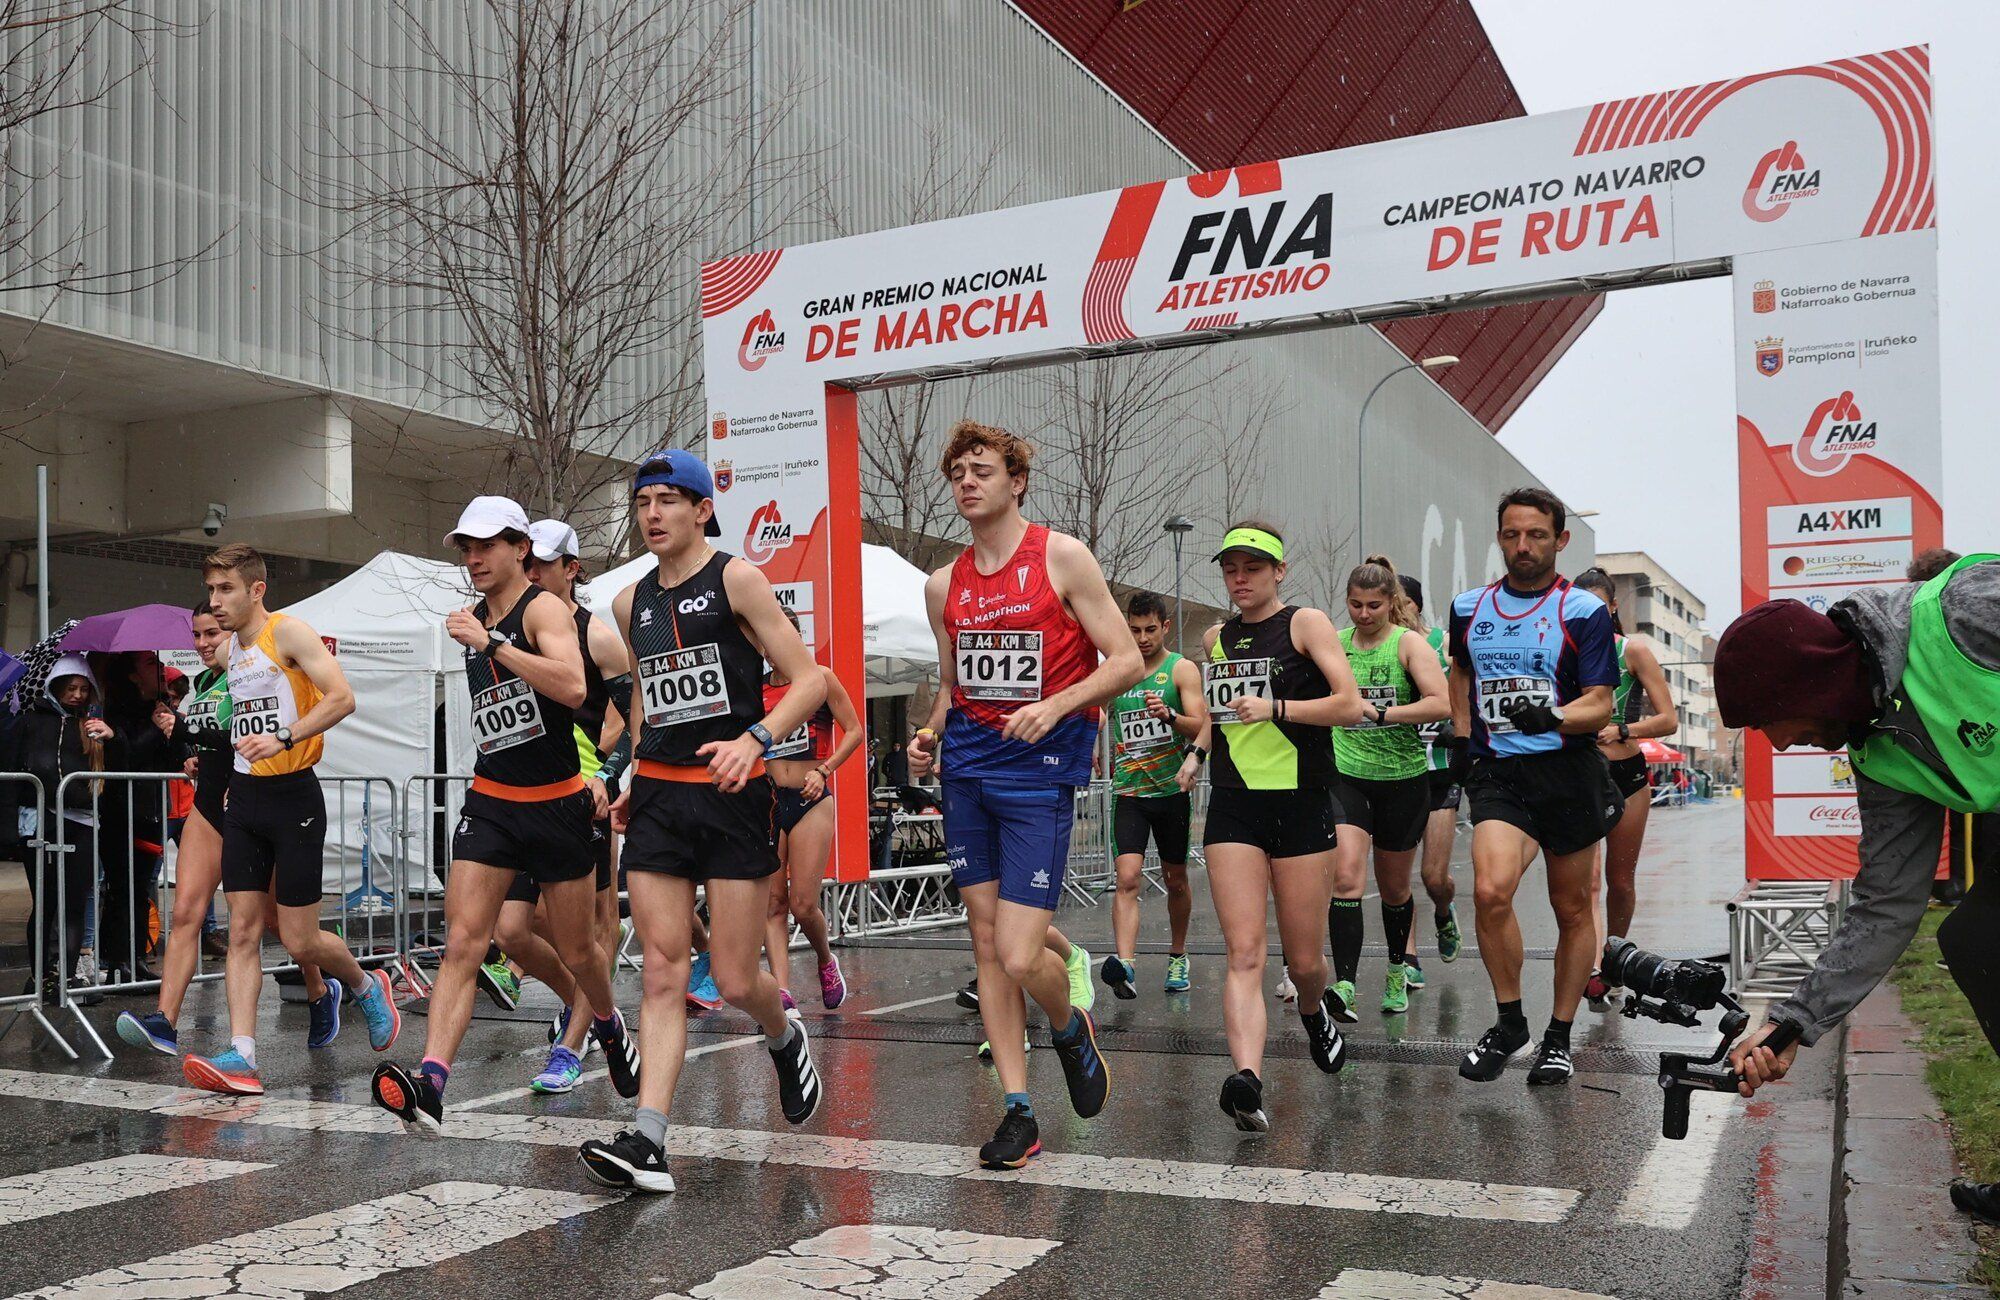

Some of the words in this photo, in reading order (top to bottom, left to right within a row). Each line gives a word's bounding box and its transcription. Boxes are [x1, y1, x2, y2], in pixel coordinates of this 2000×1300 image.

[1383, 178, 1564, 227] CAMPEONATO
[1573, 154, 1706, 198] NAVARRO
[1770, 168, 1821, 194] FNA
[1766, 187, 1820, 203] ATLETISMO
[1168, 192, 1334, 282] FNA
[1426, 218, 1501, 272] DE
[1521, 193, 1659, 258] RUTA
[803, 293, 855, 319] GRAN
[862, 280, 934, 312] PREMIO
[942, 262, 1048, 294] NACIONAL
[1155, 262, 1333, 313] ATLETISMO
[1780, 283, 1838, 298] Gobierno
[1841, 280, 1857, 291] de
[1860, 274, 1910, 288] Navarra
[1781, 294, 1850, 310] Nafarroako
[1853, 287, 1916, 302] Gobernua
[805, 317, 861, 362] DE
[873, 289, 1049, 353] MARCHA
[752, 344, 785, 356] ATLETISMO
[755, 331, 785, 350] FNA
[1864, 334, 1917, 349] Iruñeko
[1788, 349, 1855, 365] Pamplona
[730, 414, 767, 427] Gobierno
[769, 412, 780, 421] de
[781, 408, 814, 420] Navarra
[730, 425, 776, 437] Nafarroako
[777, 418, 818, 432] Gobernua
[1825, 421, 1877, 444] FNA
[1821, 440, 1876, 453] ATLETISMO
[785, 458, 819, 470] Iruñeko
[735, 471, 779, 483] Pamplona
[1797, 507, 1882, 534] A4XKM
[760, 523, 791, 540] FNA
[758, 538, 791, 547] ATLETISMO
[1806, 554, 1865, 564] RIESGO
[678, 596, 709, 614] GO
[705, 590, 716, 600] fit
[975, 603, 1031, 624] MARATHON
[975, 634, 1020, 649] A4XKM
[176, 659, 200, 667] Navarra
[654, 651, 697, 675] A4XKM
[1477, 652, 1520, 661] CONCELLO
[1483, 663, 1493, 671] DE
[962, 655, 1038, 682] 1012
[1216, 662, 1251, 678] A4XKM
[481, 684, 513, 708] A4XKM
[646, 670, 722, 708] 1008
[1206, 681, 1267, 708] 1017
[1495, 678, 1534, 693] A4XKM
[233, 714, 280, 738] 1005
[474, 699, 536, 737] 1009
[1124, 721, 1168, 739] 1011
[1973, 722, 1996, 745] FNA
